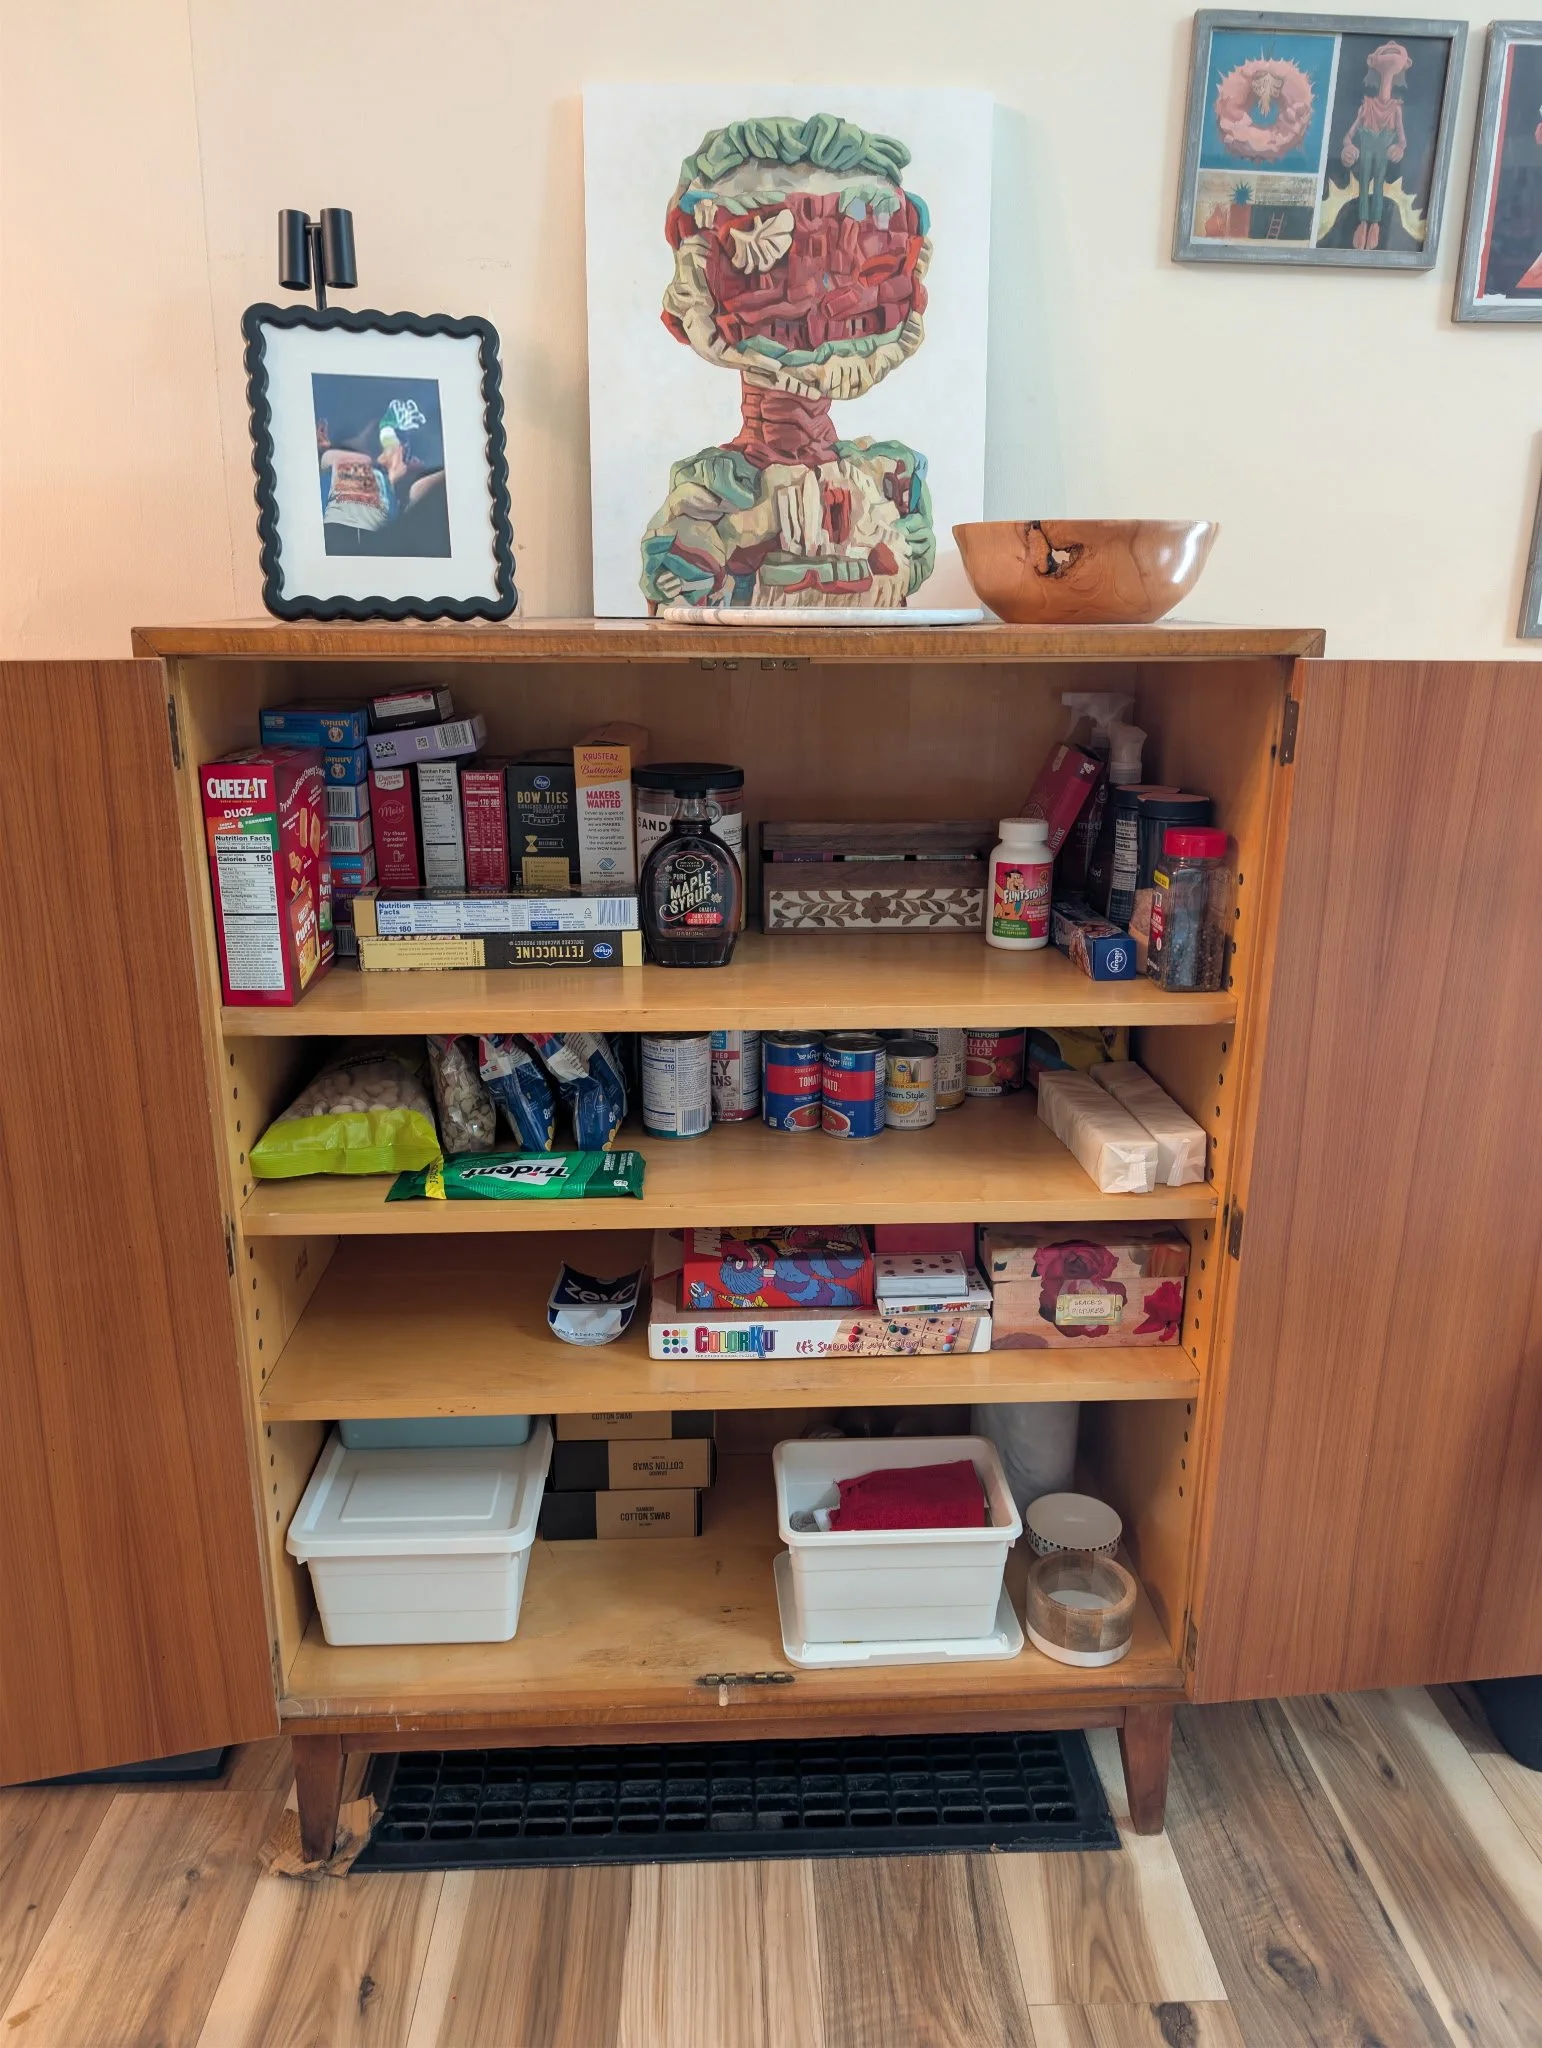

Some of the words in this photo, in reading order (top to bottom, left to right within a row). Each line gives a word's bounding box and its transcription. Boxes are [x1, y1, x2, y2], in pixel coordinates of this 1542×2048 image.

[582, 752, 618, 762] KRUSTEAZ
[580, 765, 623, 775] Buttermilk
[517, 791, 540, 803] BOW
[545, 791, 568, 803] TIES
[586, 791, 620, 799] MAKERS
[587, 800, 622, 808] WANTED
[224, 807, 254, 818] DUOZ
[378, 805, 405, 817] Moist
[237, 821, 244, 829] &
[670, 870, 711, 900] MAPLE
[670, 886, 712, 914] SYRUP
[516, 946, 584, 959] FETTUCCINE
[595, 946, 612, 956] Kroger
[1110, 950, 1123, 972] Kroger
[799, 1074, 820, 1088] TOMAT
[905, 1091, 924, 1101] Style
[460, 1166, 569, 1179] Trident
[796, 1341, 813, 1354] It's
[616, 1412, 632, 1420] SWAB
[633, 1462, 654, 1470] SWAB
[655, 1462, 684, 1470] COTTON
[650, 1512, 670, 1520] SWAB
